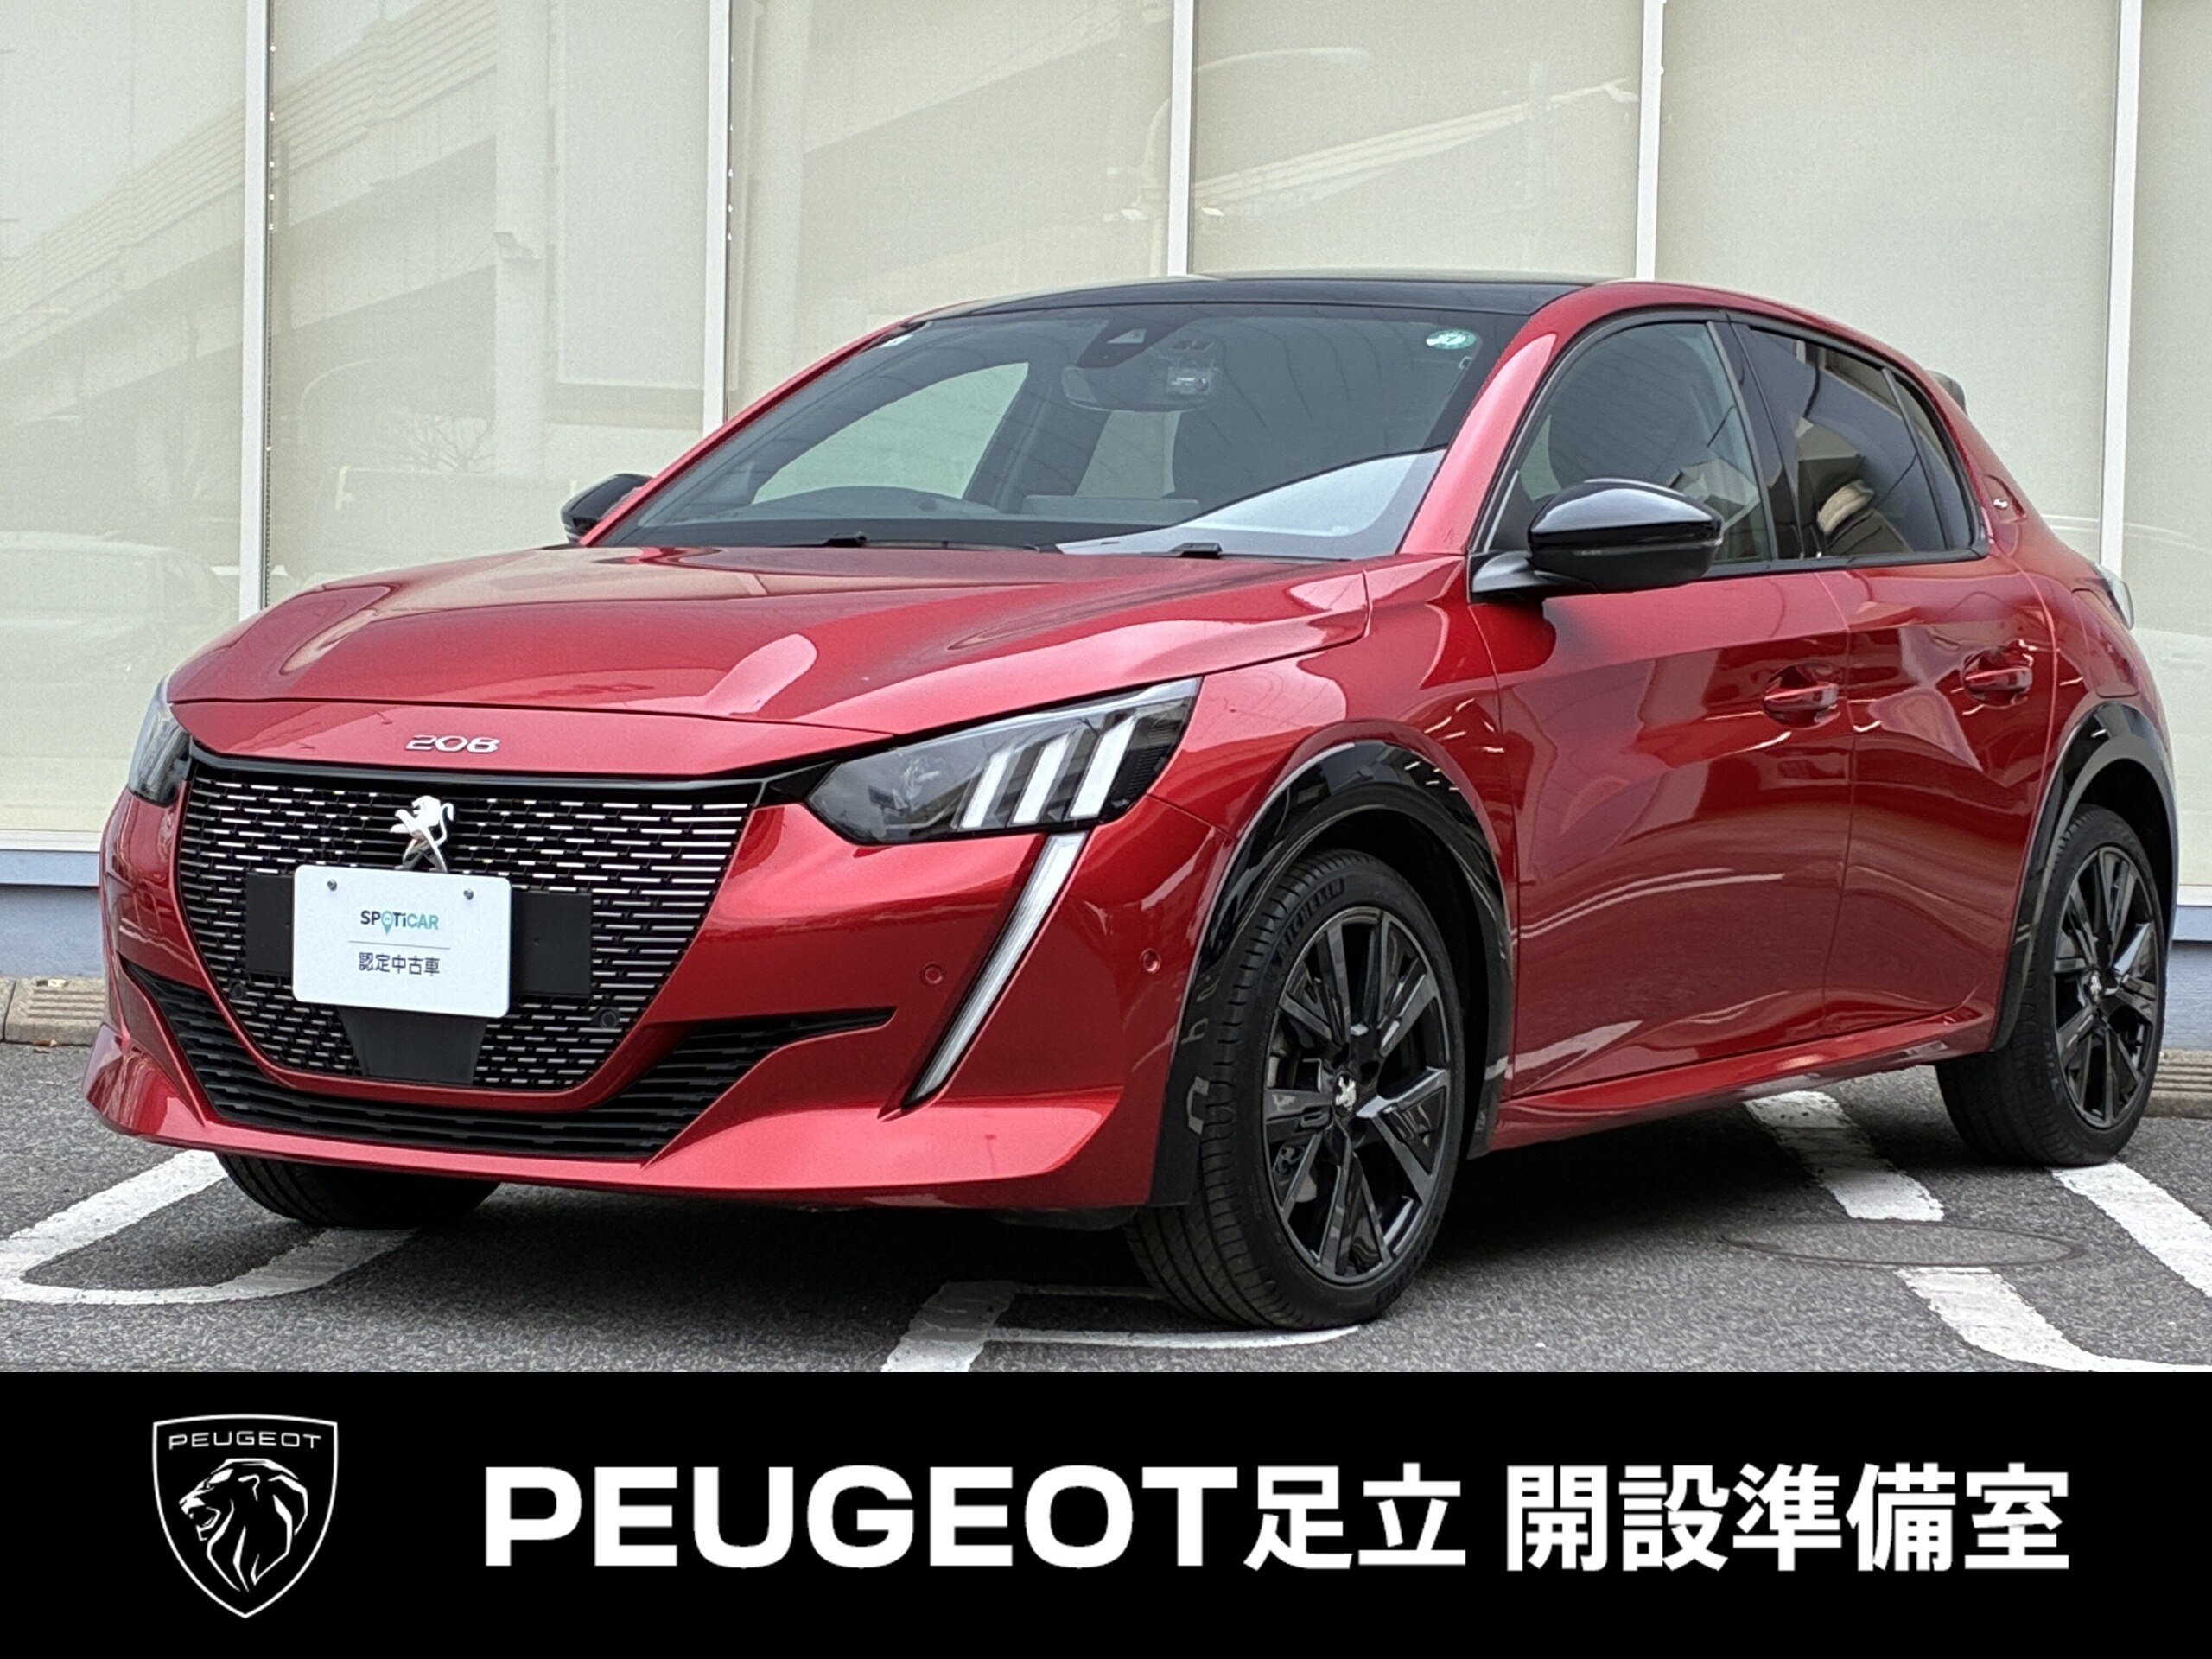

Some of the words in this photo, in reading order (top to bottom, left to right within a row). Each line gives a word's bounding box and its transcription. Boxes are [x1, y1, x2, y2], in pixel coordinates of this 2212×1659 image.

[404, 734, 500, 754] 208
[359, 952, 441, 976] 認定中古車
